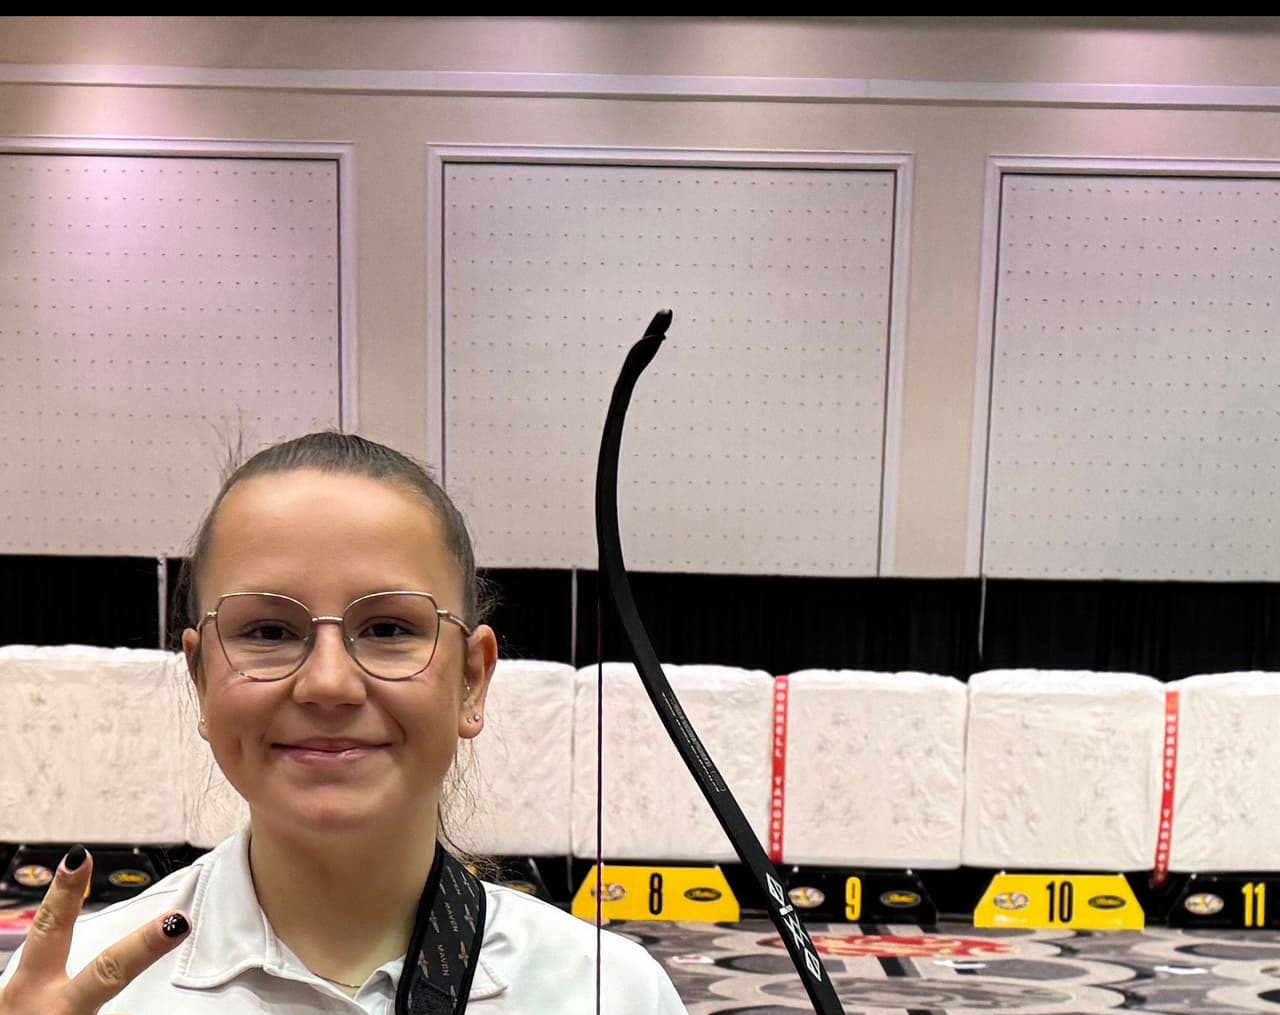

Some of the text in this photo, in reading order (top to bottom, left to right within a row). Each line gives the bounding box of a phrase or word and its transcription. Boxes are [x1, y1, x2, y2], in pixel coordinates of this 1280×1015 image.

[772, 681, 787, 851] MORRELL TARGETS
[1164, 714, 1178, 790] MORRELL
[648, 872, 663, 915] 8
[845, 876, 862, 921] 9
[1045, 881, 1074, 924] 10
[1241, 882, 1266, 928] 11
